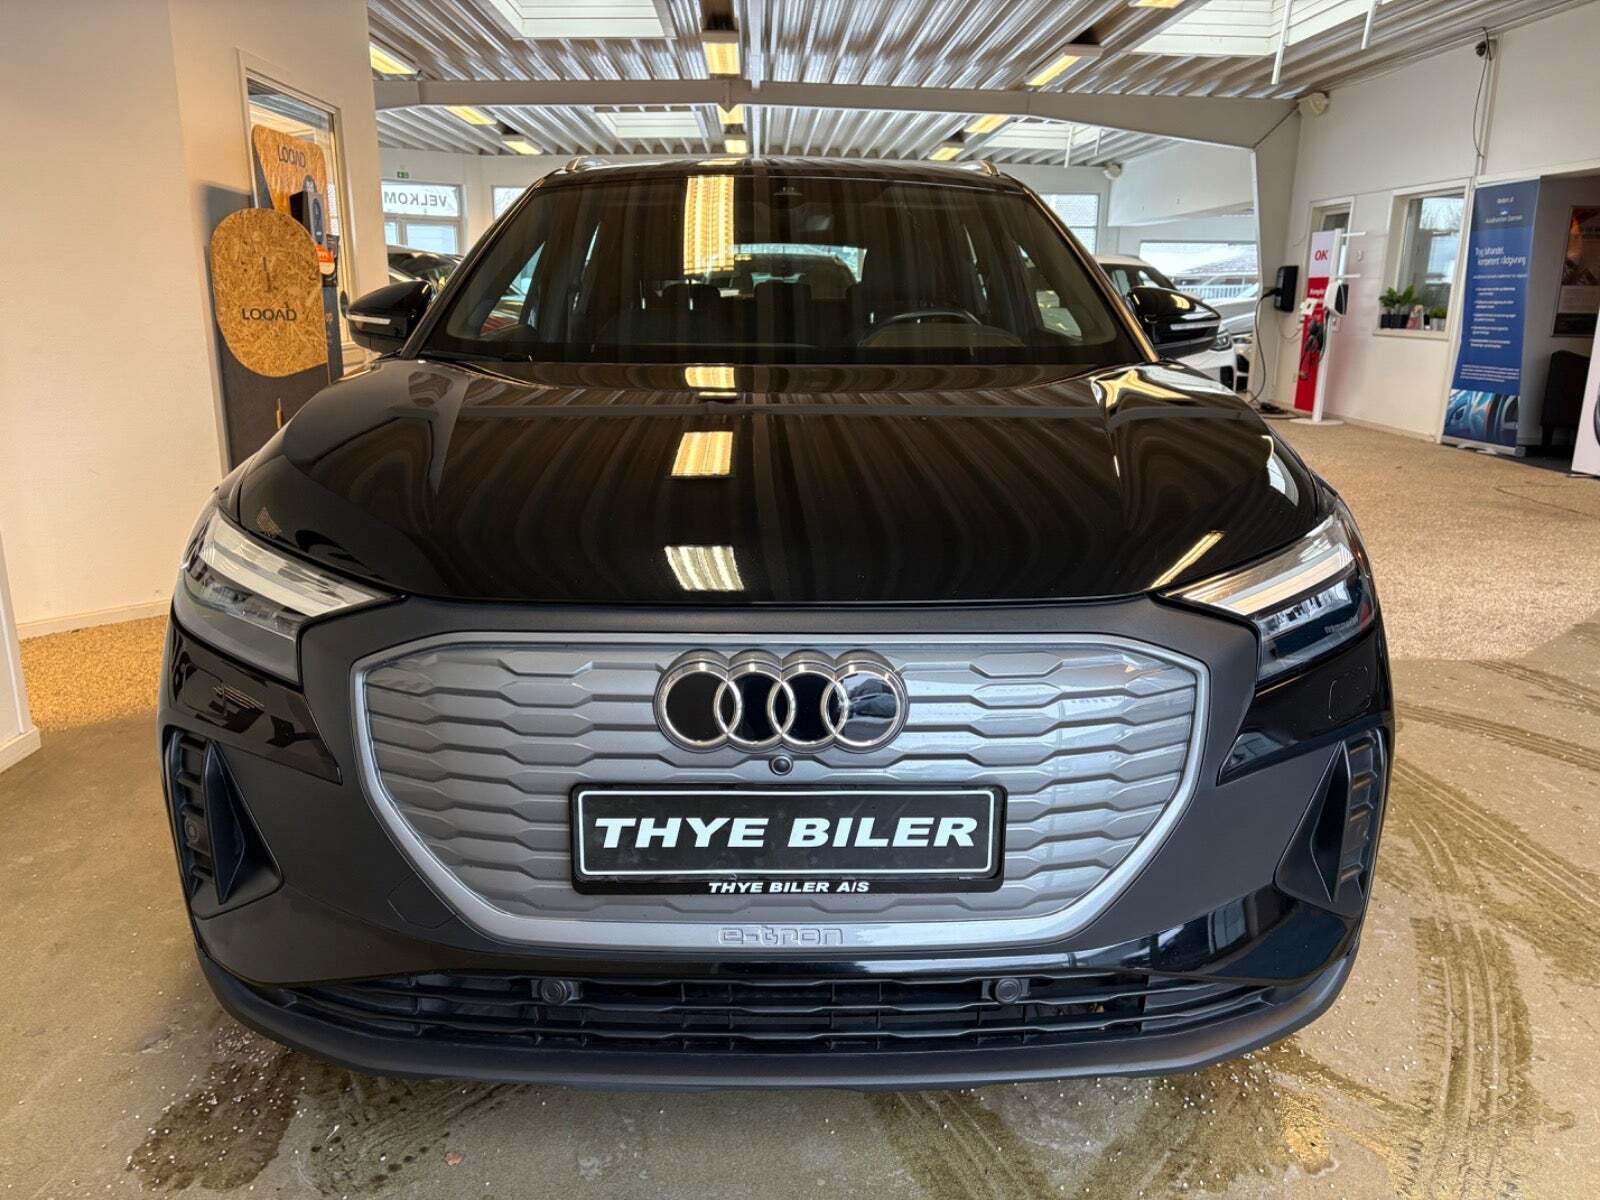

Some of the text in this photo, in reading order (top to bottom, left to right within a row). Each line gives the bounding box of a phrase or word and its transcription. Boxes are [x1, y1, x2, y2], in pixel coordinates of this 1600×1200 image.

[1314, 249, 1329, 261] OK
[595, 817, 978, 848] THYE BILER
[708, 881, 870, 893] THYE BILER A/S
[718, 925, 844, 945] e-tron
